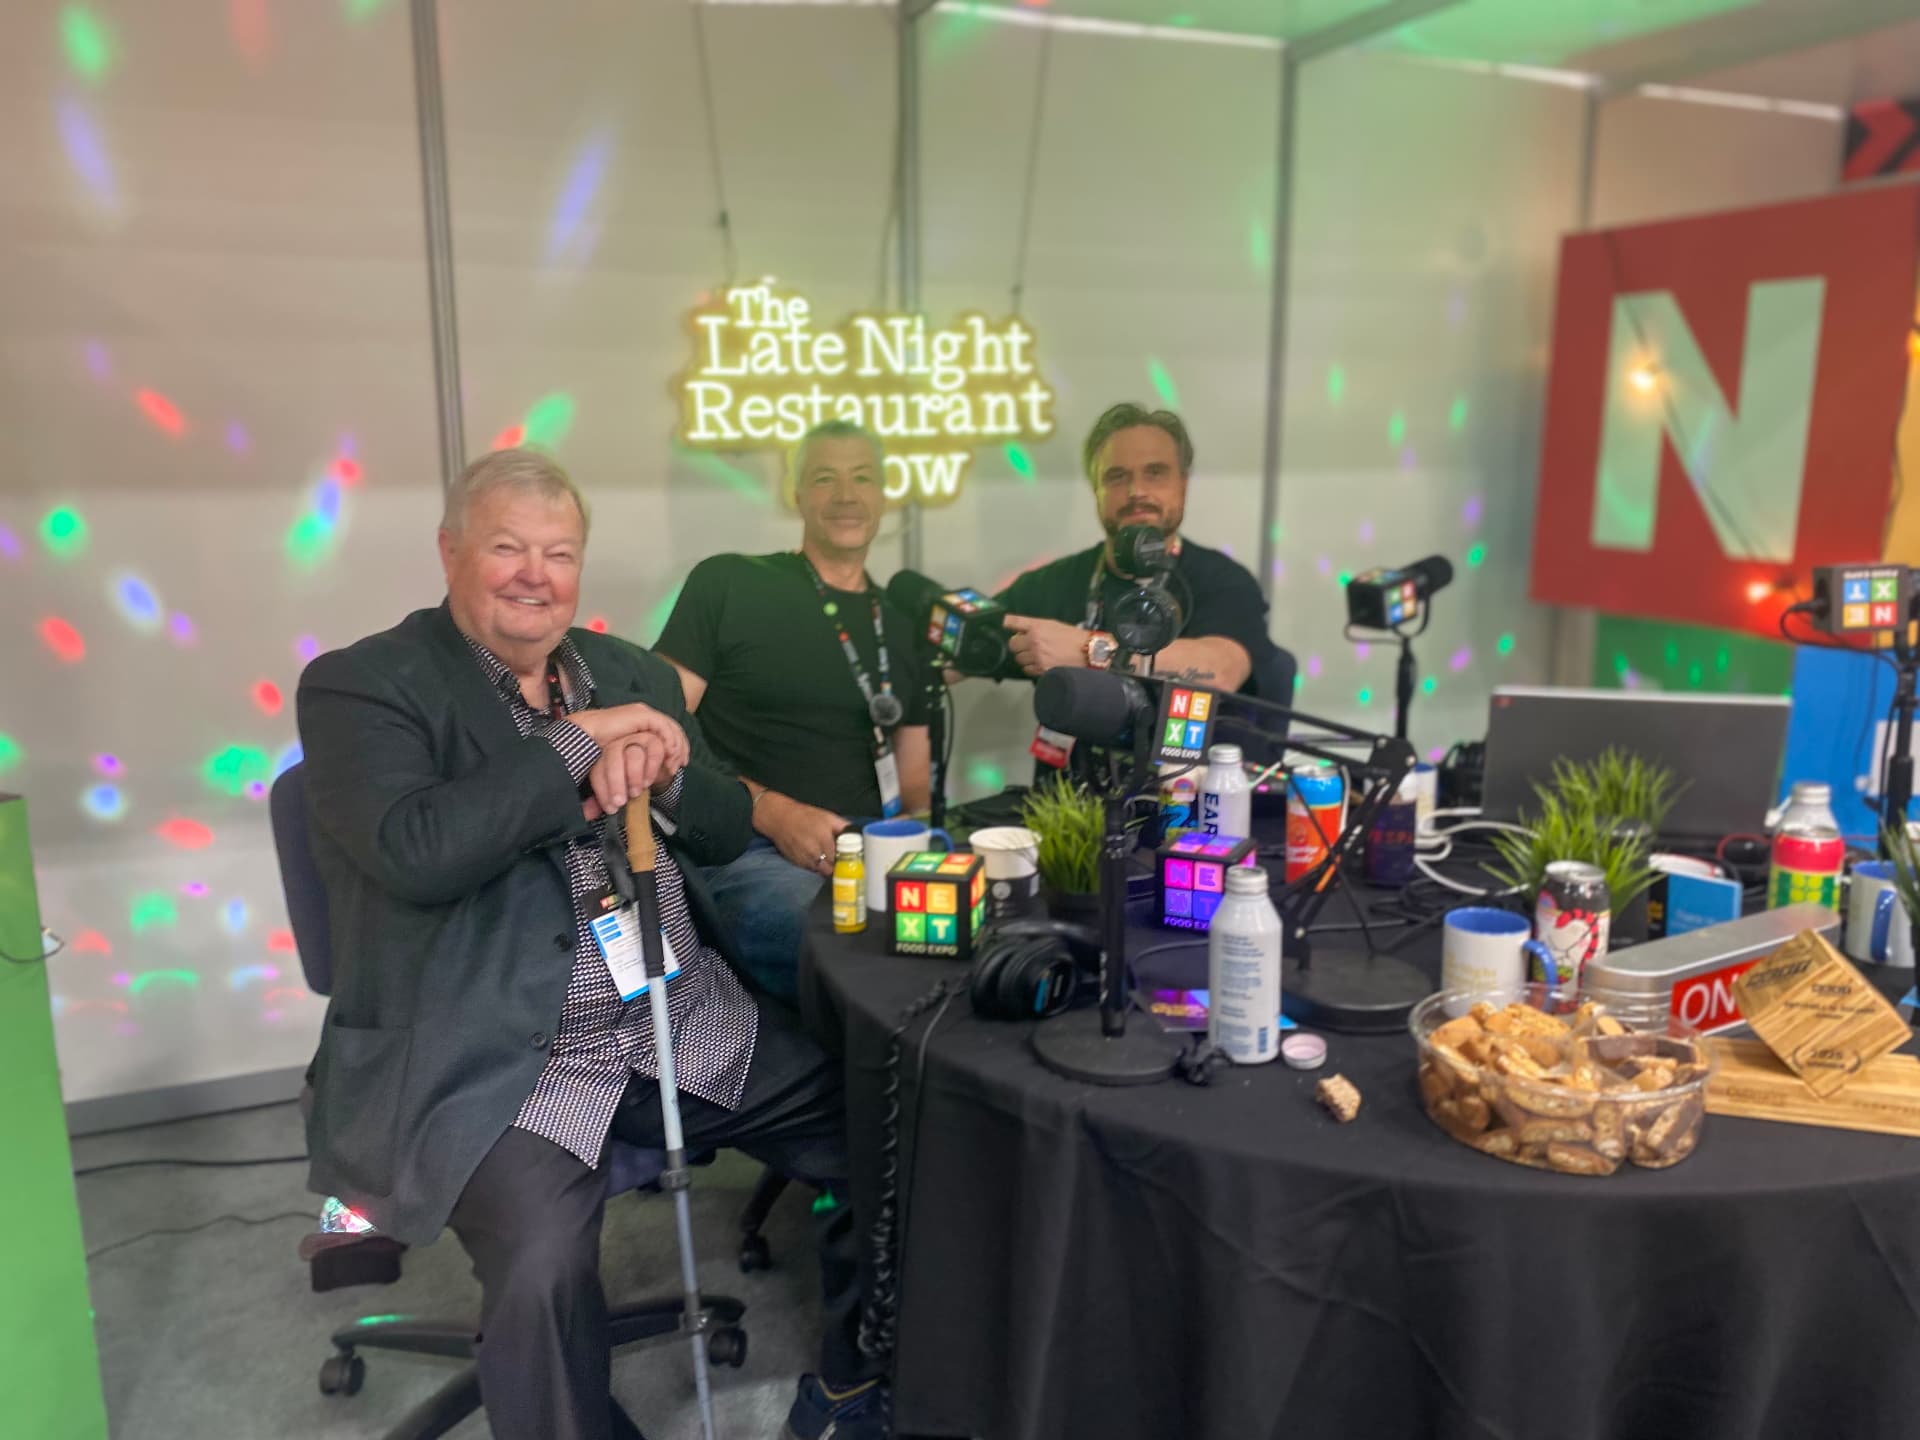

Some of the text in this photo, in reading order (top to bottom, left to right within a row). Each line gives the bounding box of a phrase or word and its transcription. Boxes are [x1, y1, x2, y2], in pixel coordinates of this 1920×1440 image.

[727, 275, 810, 329] The
[697, 313, 1034, 392] Late Night
[685, 380, 1053, 441] Restaurant
[1591, 275, 1826, 562] N
[882, 453, 970, 499] ow
[1160, 746, 1202, 760] FOOD EXPO
[1163, 916, 1192, 929] FOOD
[896, 942, 959, 956] FOOD EXPO
